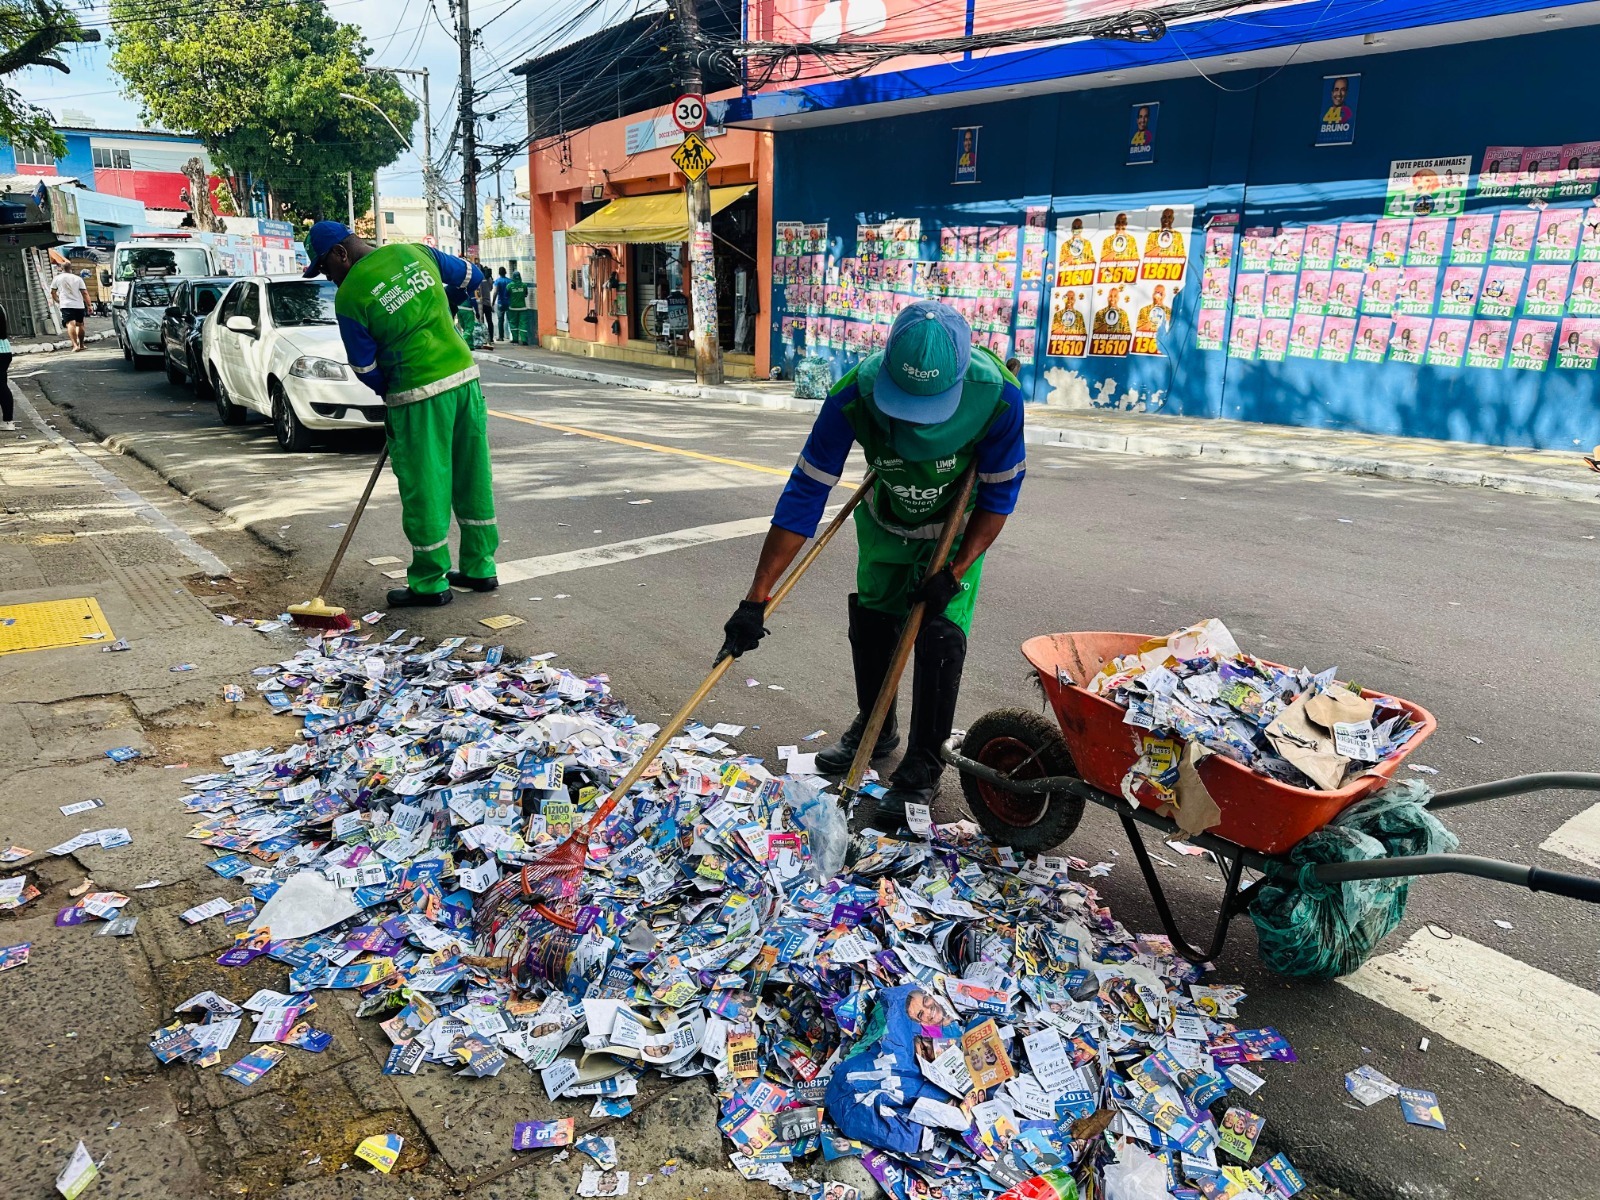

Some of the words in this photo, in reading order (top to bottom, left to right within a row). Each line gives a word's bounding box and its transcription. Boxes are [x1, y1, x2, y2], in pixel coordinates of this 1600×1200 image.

[678, 104, 702, 120] 30
[1323, 107, 1342, 124] 44
[1321, 123, 1350, 133] BRUNO
[1130, 132, 1146, 146] 44
[1129, 145, 1151, 154] BRUNO
[1395, 160, 1412, 169] VOTE
[1413, 159, 1433, 168] PELOS
[1480, 185, 1509, 197] 20123
[1518, 188, 1549, 198] 20123
[1560, 184, 1592, 195] 20123
[1389, 193, 1415, 215] 45
[1435, 190, 1461, 214] 45
[1411, 254, 1437, 265] 20123
[1454, 252, 1483, 264] 20123
[1495, 250, 1525, 261] 20123
[1540, 249, 1571, 260] 20123
[1584, 248, 1600, 260] 201
[1245, 260, 1267, 269] 20123
[1273, 262, 1296, 271] 20123
[1306, 260, 1330, 269] 20123
[1143, 263, 1183, 279] 13610
[407, 270, 436, 293] 156
[1060, 270, 1093, 286] 13610
[379, 285, 403, 307] DISQUE
[386, 288, 415, 315] SALVADOR
[1204, 301, 1224, 309] 20123
[1300, 305, 1321, 314] 20123
[1329, 306, 1352, 315] 20123
[1365, 304, 1391, 313] 20123
[1401, 304, 1429, 313] 20123
[1443, 304, 1470, 314] 20123
[1529, 304, 1558, 314] 20123
[1573, 303, 1600, 314] 2012
[670, 309, 687, 319] GELO
[1267, 308, 1289, 317] 20123
[1482, 306, 1511, 316] 20123
[1051, 340, 1084, 355] 13610
[1093, 339, 1128, 355] 13610
[1135, 337, 1158, 353] 136
[1201, 341, 1219, 349] 20123
[1230, 351, 1250, 359] 20123
[1260, 352, 1282, 360] 20123
[1290, 349, 1313, 358] 20123
[1321, 351, 1345, 360] 20123
[1355, 352, 1381, 362] 20123
[1392, 353, 1418, 363] 20123
[1430, 354, 1457, 366] 20123
[1470, 356, 1498, 368] 20123
[1513, 358, 1542, 370] 20123
[1561, 357, 1592, 368] 20123
[902, 363, 940, 379] Sotero
[554, 763, 563, 789] 27677
[547, 805, 570, 815] 12100
[370, 824, 395, 837] 12100
[609, 969, 635, 981] 44800
[150, 1029, 182, 1047] 44800
[965, 1022, 992, 1048] 13555
[797, 1078, 829, 1089] 44800
[753, 1087, 771, 1108] 12123
[536, 1129, 550, 1140] 15
[884, 1166, 899, 1183] 15
